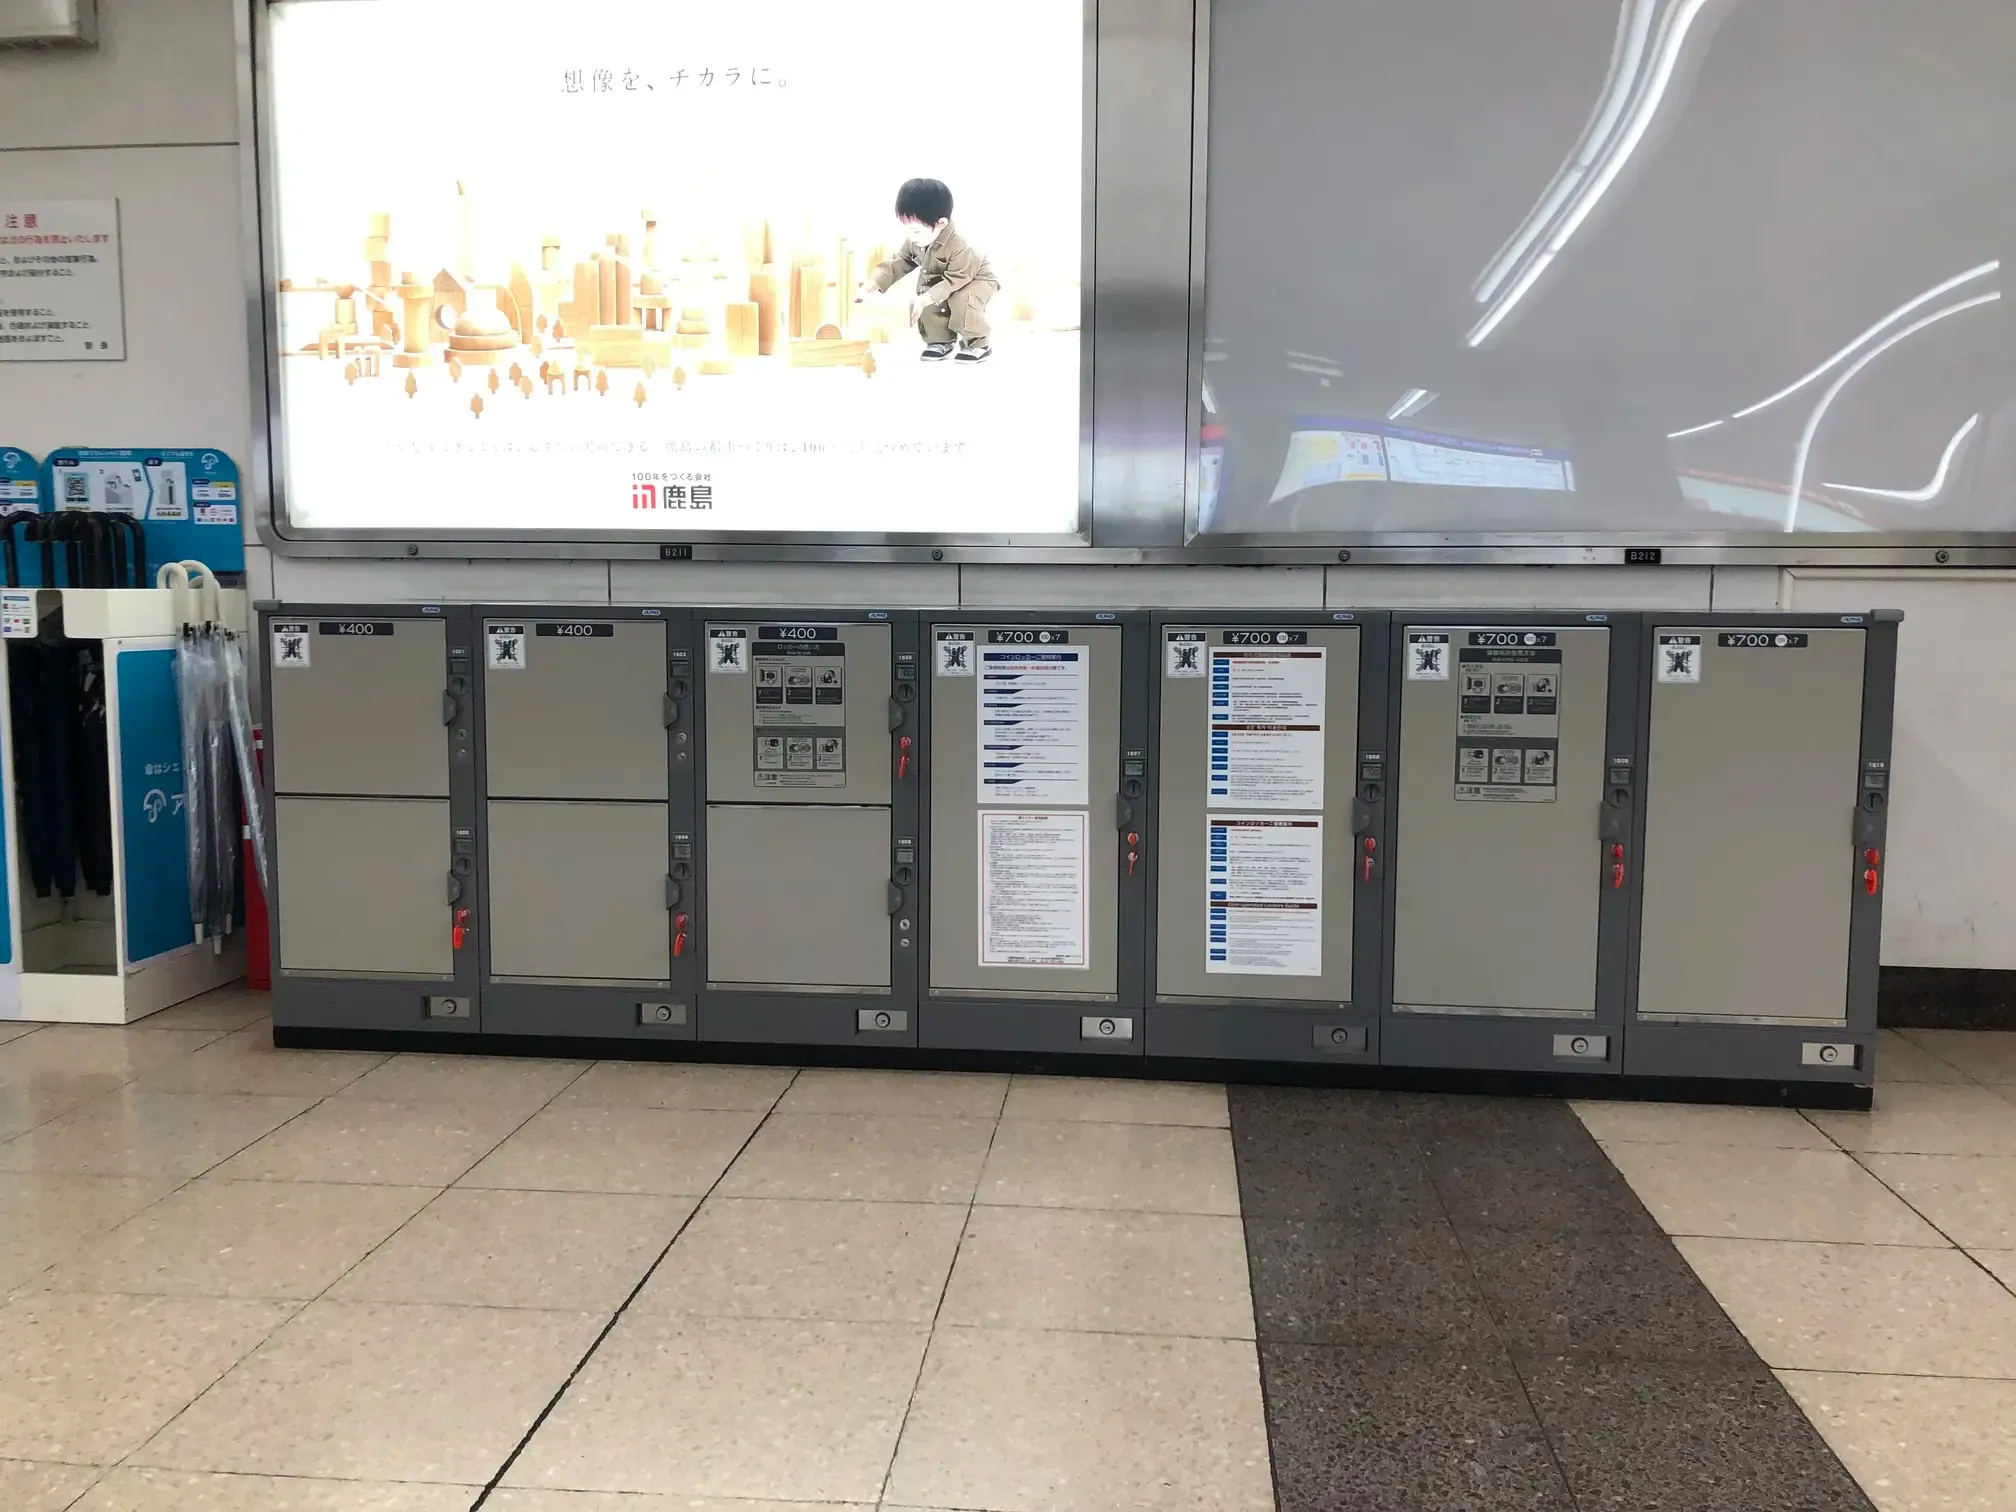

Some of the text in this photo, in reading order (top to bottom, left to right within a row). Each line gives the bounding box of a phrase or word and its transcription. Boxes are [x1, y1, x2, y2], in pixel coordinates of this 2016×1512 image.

[561, 67, 787, 93] 想像を、チカラに。
[632, 472, 712, 481] 100年をつくる会社
[663, 484, 712, 510] 鹿島
[1630, 552, 1656, 560] B212
[339, 624, 374, 634] ¥400
[556, 625, 592, 636] ¥400
[780, 628, 816, 638] ¥400
[996, 632, 1034, 642] ¥700
[1232, 632, 1270, 644] ¥700
[1478, 634, 1518, 644] ¥700
[1728, 634, 1769, 646] ¥700
